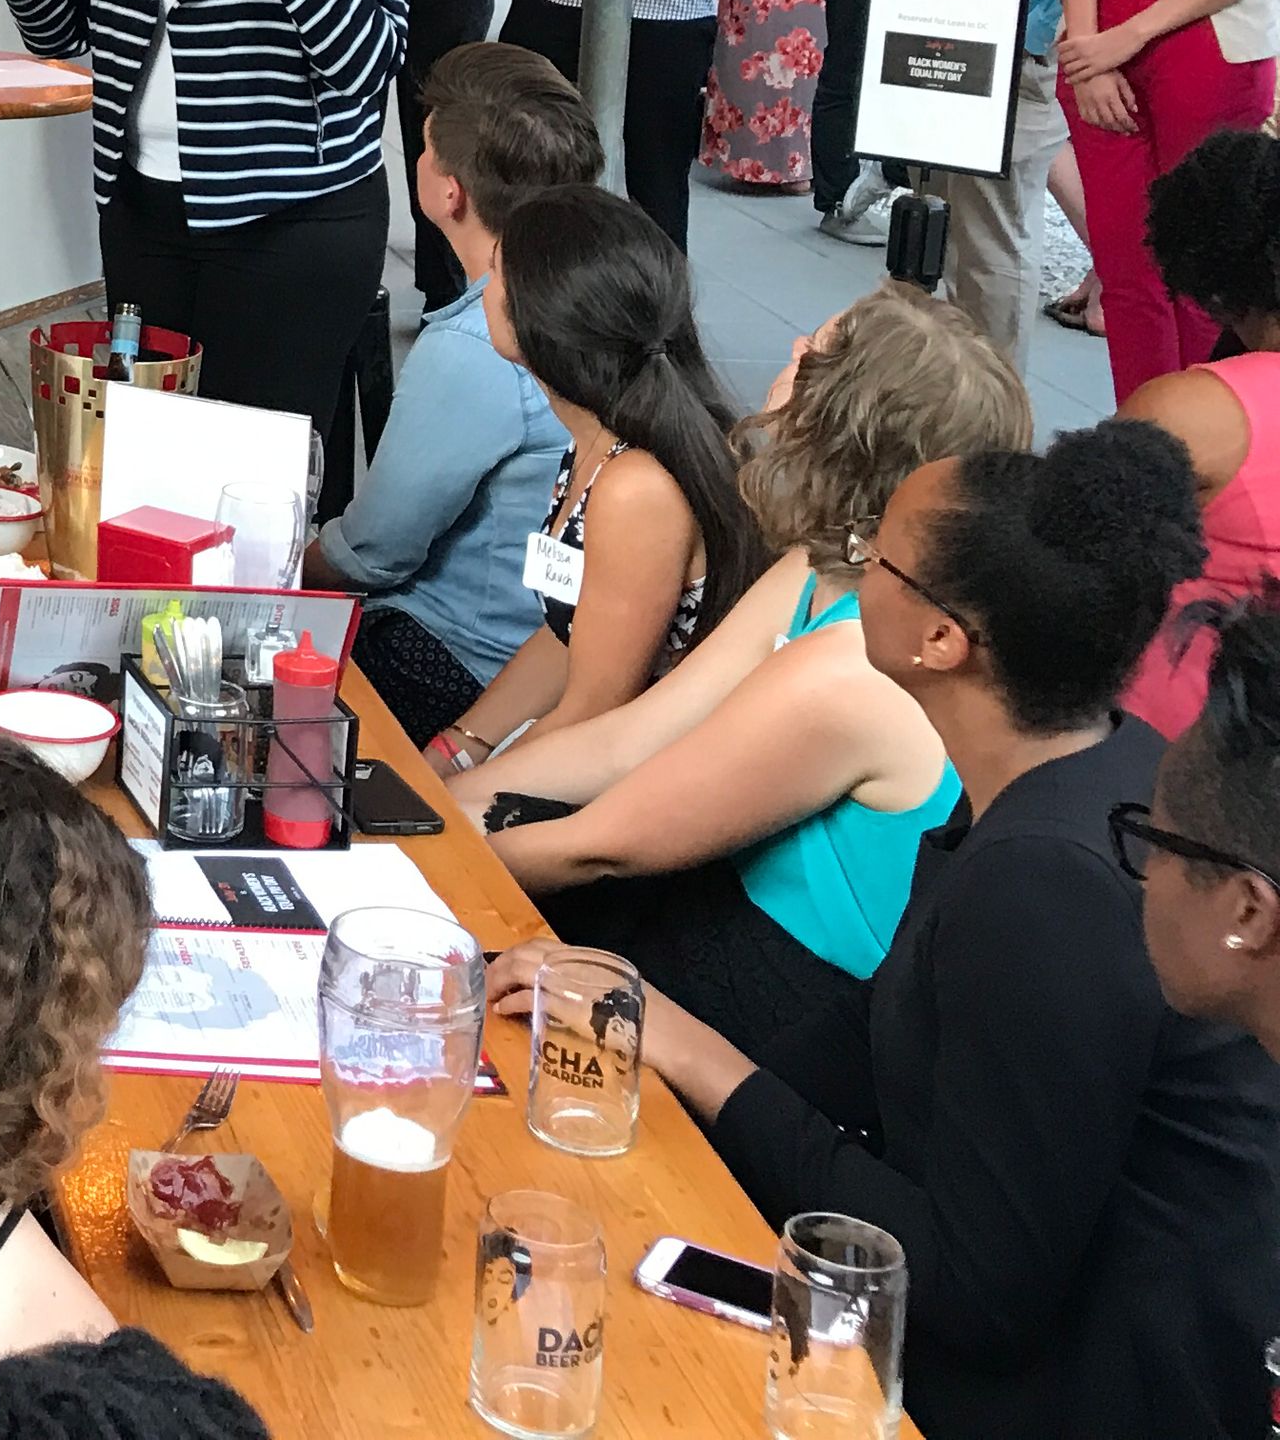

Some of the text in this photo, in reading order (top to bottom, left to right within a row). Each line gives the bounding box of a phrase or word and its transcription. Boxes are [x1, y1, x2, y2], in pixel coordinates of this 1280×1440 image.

[907, 55, 967, 72] BLACK WOMEN'S
[909, 67, 963, 82] EQUAL PAY DAY
[232, 938, 253, 970] SKEWERS
[291, 940, 308, 961] BRATS
[541, 1040, 604, 1077] CHA
[541, 1061, 605, 1089] GARDEN
[538, 1319, 603, 1353] DAC
[536, 1352, 581, 1368] BEER
